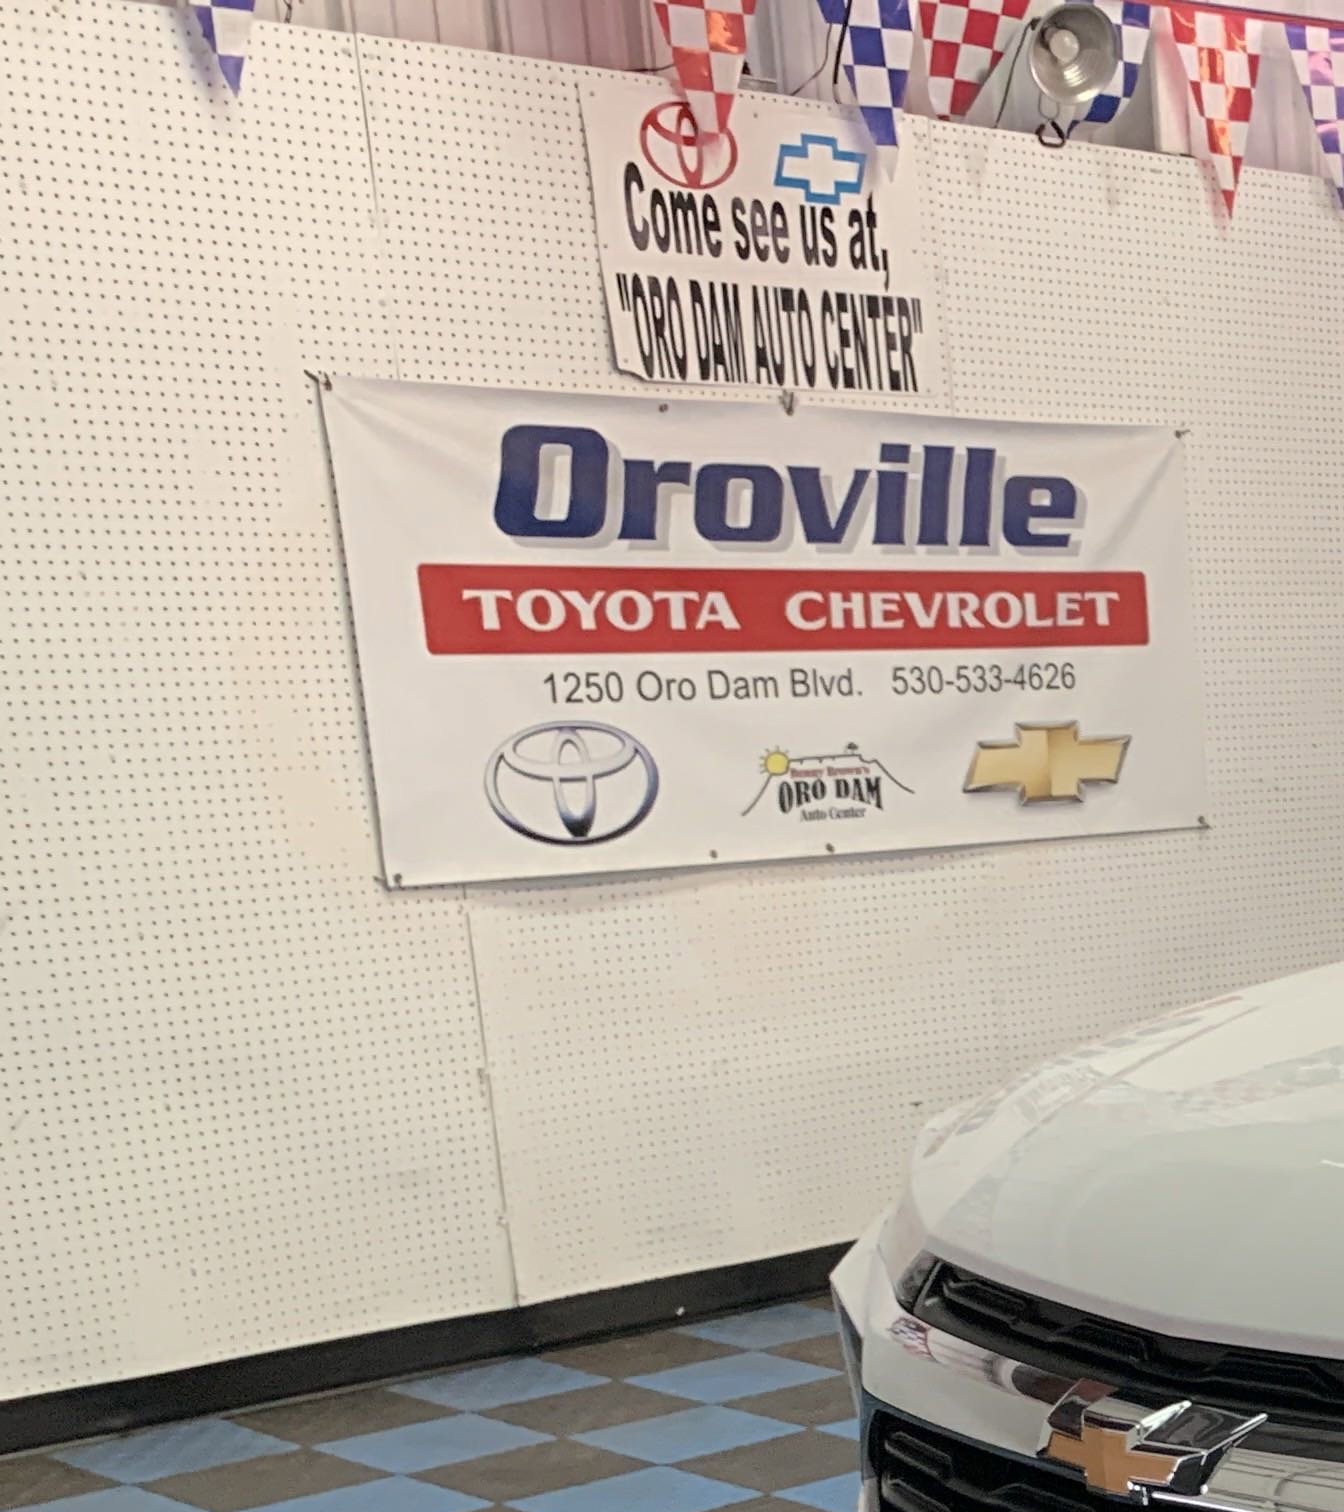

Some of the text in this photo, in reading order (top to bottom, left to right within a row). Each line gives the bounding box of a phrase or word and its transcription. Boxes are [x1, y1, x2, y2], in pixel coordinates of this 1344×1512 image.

[624, 161, 890, 292] Come see us at,
[616, 272, 924, 393] "ORO DAM AUTO CENTER"
[494, 423, 1077, 547] Oroville
[463, 589, 1120, 633] TOYOTA CHEVROLET
[542, 662, 1077, 704] 1250 Oro Dam Blvd. 530-533-4626
[779, 776, 884, 813] ORO DAM
[801, 806, 867, 822] Auto Center
